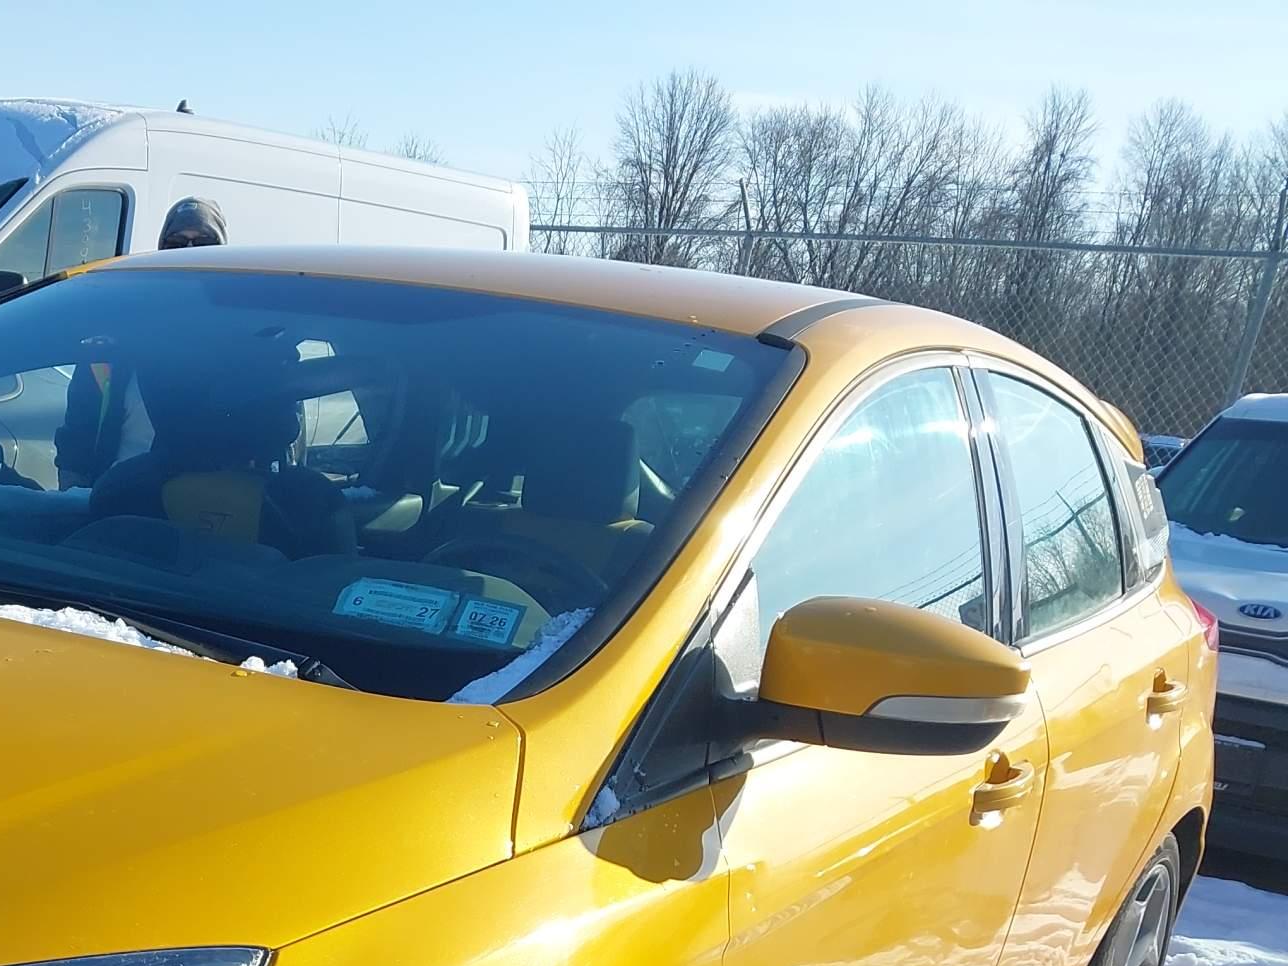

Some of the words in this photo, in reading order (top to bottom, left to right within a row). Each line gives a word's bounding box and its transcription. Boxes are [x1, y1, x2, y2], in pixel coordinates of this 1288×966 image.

[352, 596, 364, 606] 6
[416, 607, 440, 620] 27
[1243, 604, 1275, 618] KIA
[469, 611, 487, 622] 07
[489, 616, 508, 627] 26
